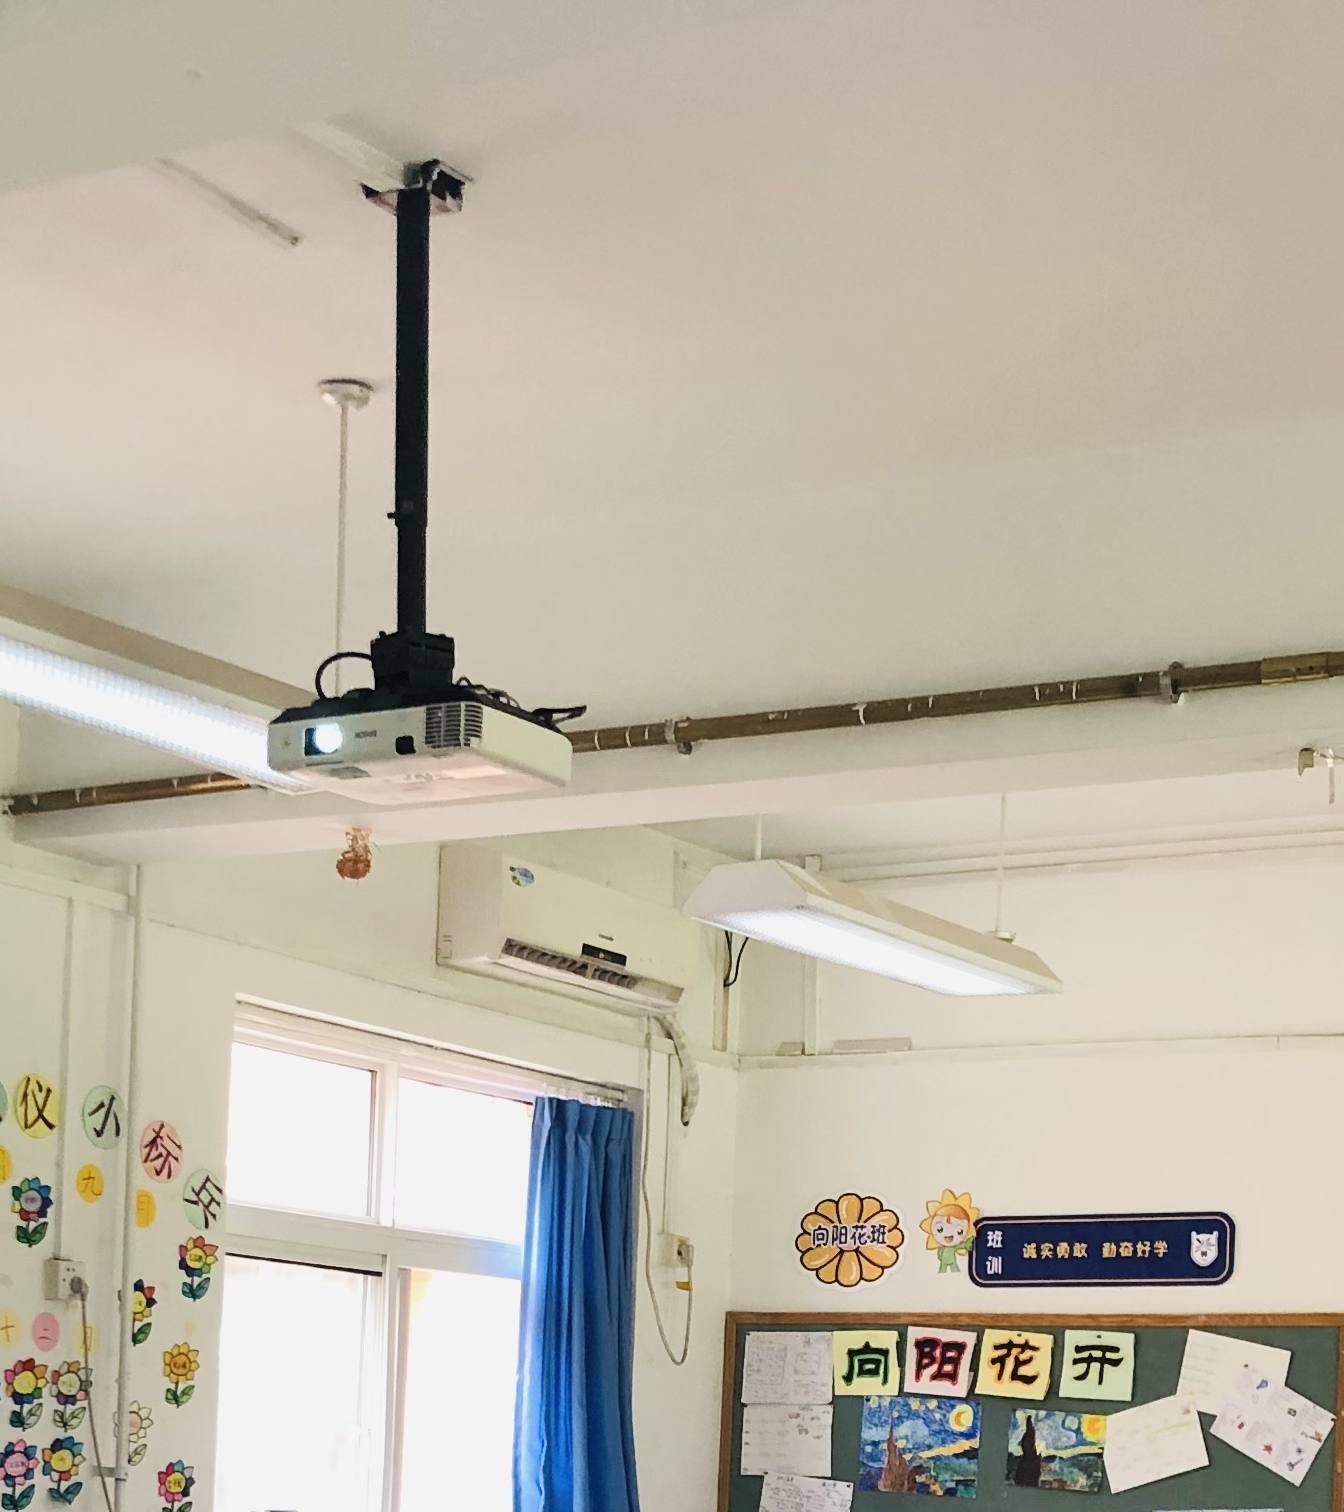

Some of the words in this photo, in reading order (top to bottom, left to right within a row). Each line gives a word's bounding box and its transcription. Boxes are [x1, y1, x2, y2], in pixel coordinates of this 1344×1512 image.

[812, 1223, 888, 1248] 向阳花班
[841, 1336, 1124, 1389] 向阳花开
